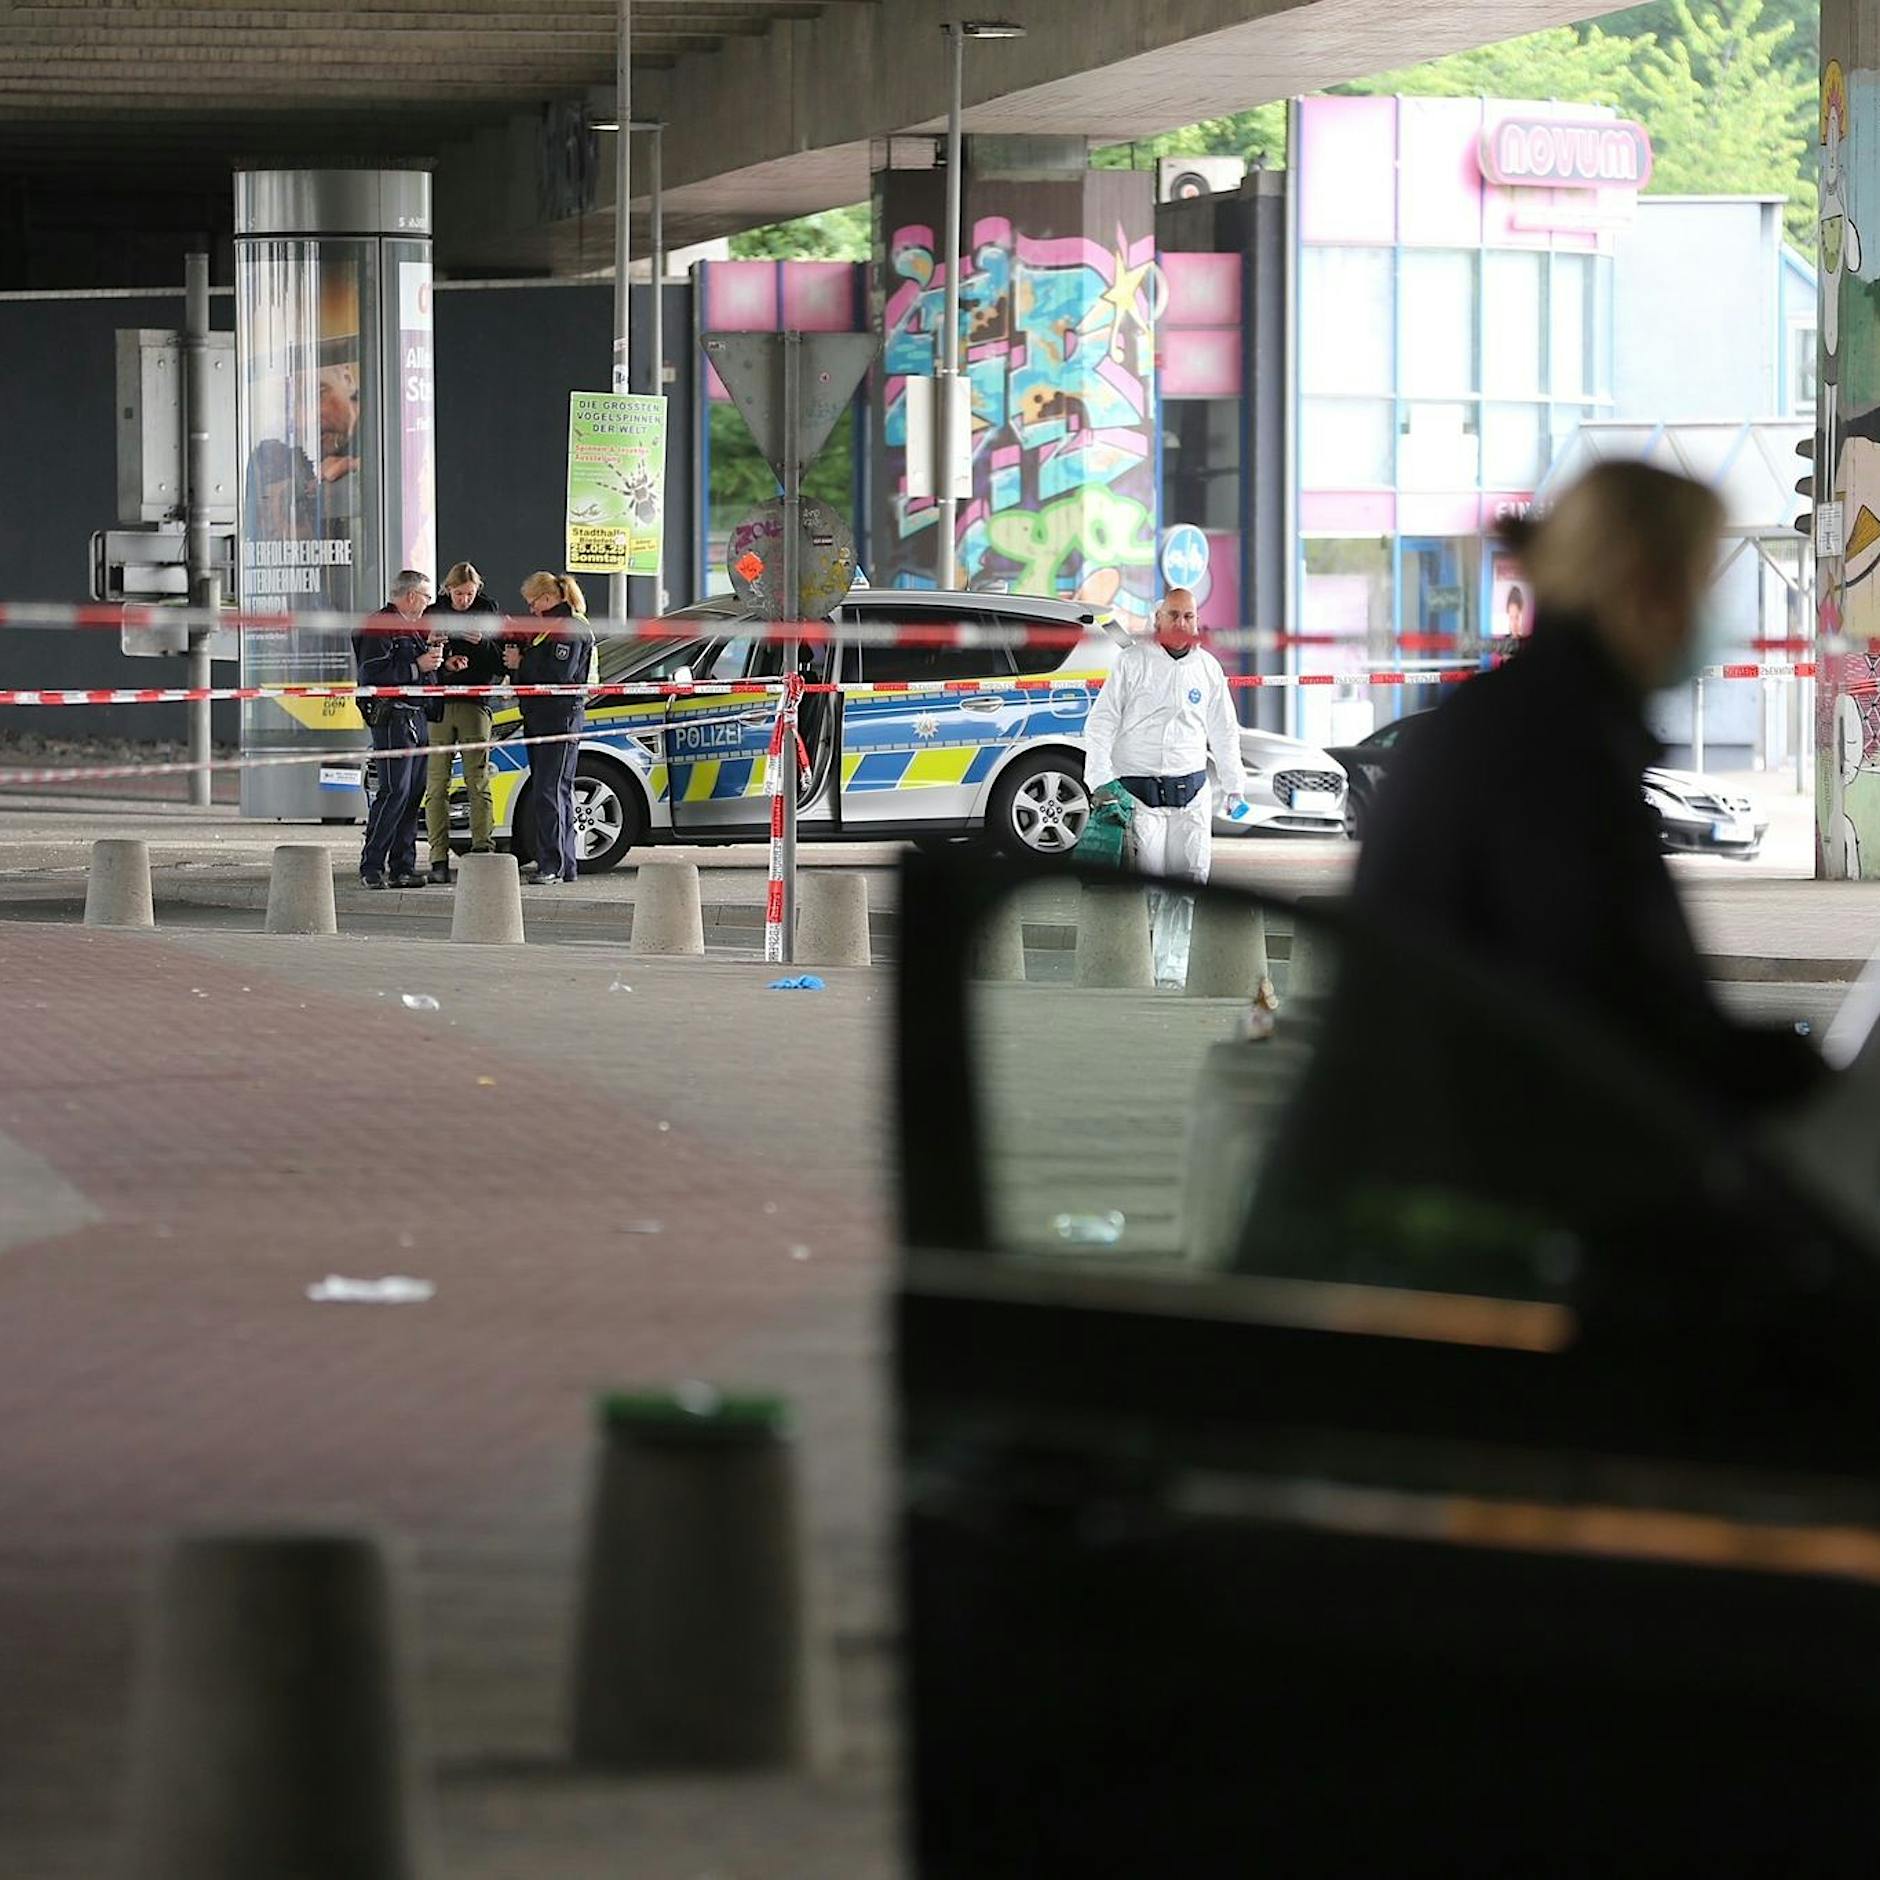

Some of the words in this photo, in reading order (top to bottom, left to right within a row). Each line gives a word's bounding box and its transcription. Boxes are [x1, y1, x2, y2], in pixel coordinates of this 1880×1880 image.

[579, 400, 598, 410] DIE
[576, 412, 661, 424] VOGELSPINNEN
[592, 424, 616, 433] DER
[571, 554, 625, 565] Sonntag
[675, 722, 742, 749] POLIZEI
